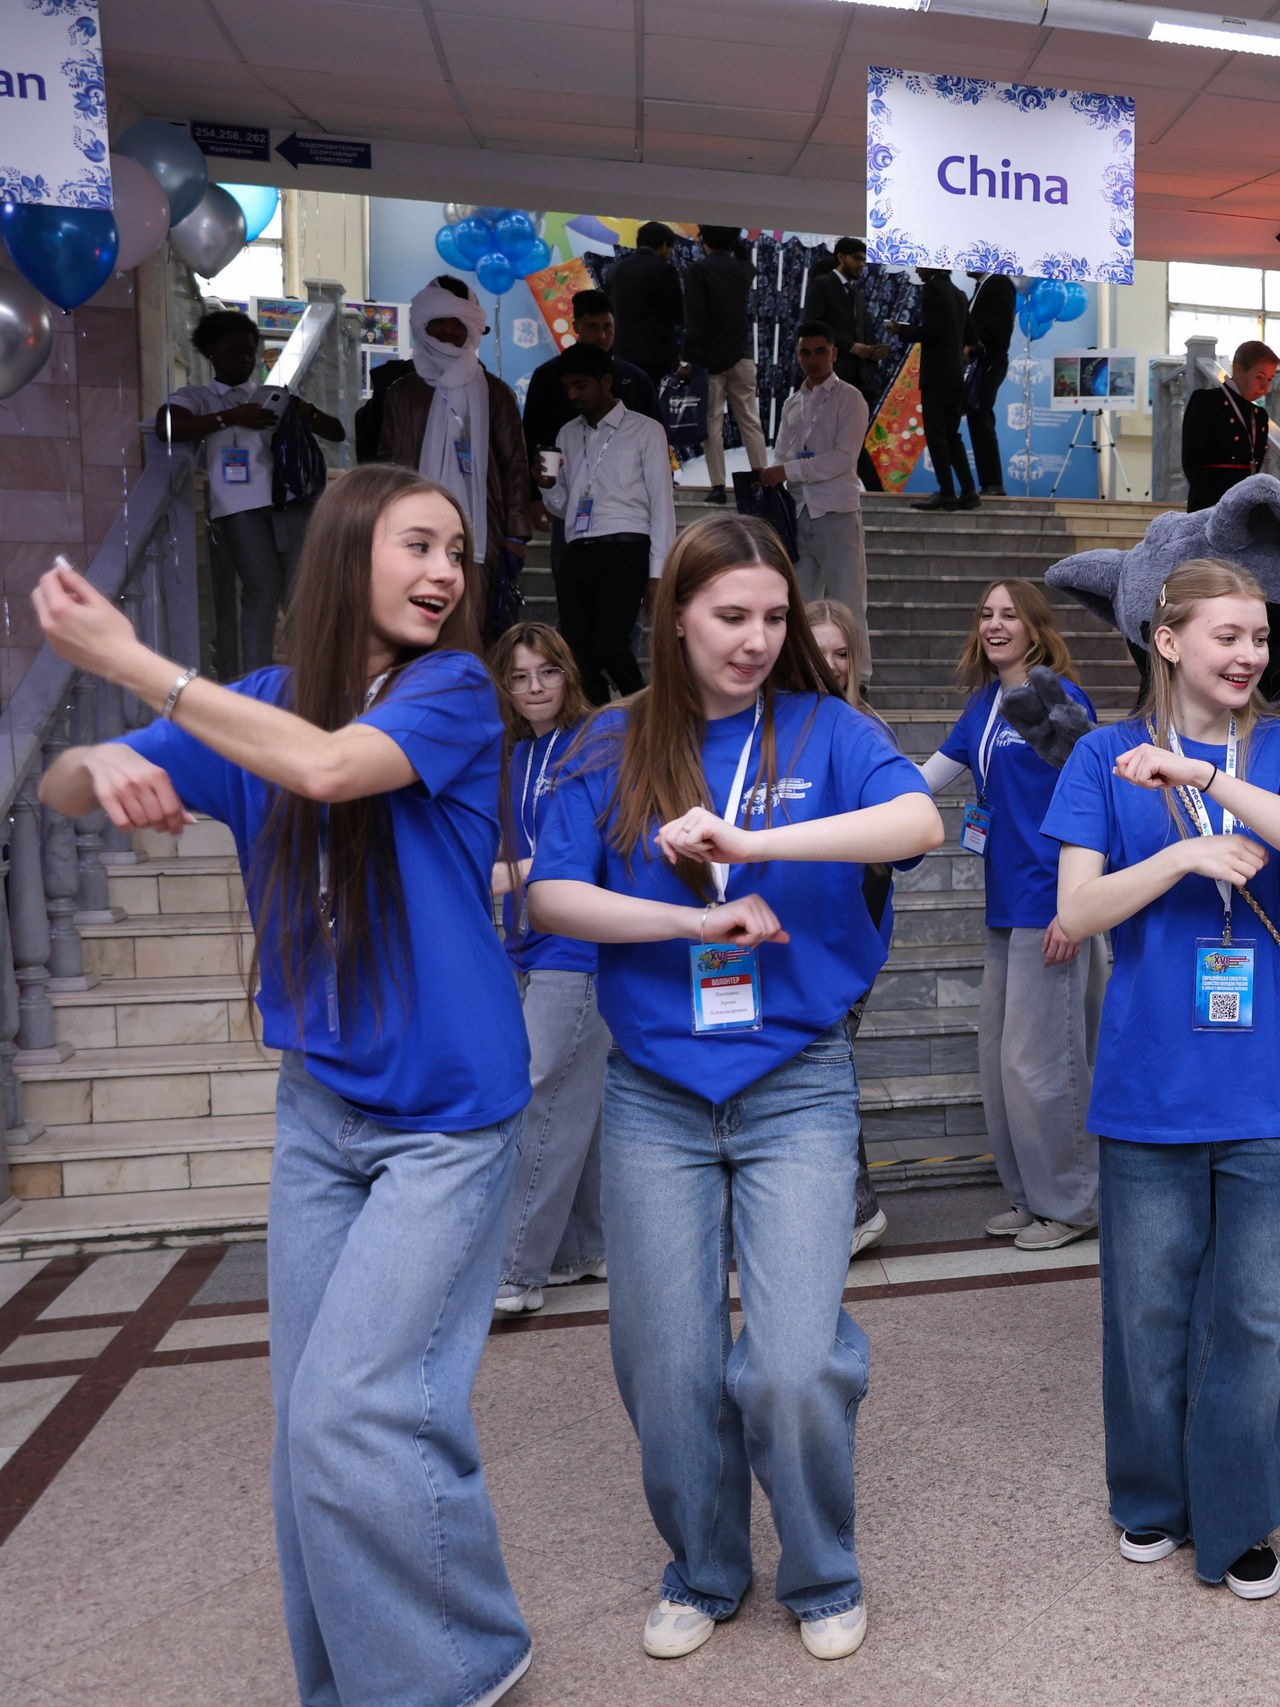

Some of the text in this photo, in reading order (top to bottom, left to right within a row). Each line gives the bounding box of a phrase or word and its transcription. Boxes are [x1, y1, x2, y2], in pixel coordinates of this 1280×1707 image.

[246, 132, 266, 143] 262
[937, 154, 1069, 206] China
[711, 976, 740, 986] ВОЛОНТЕР
